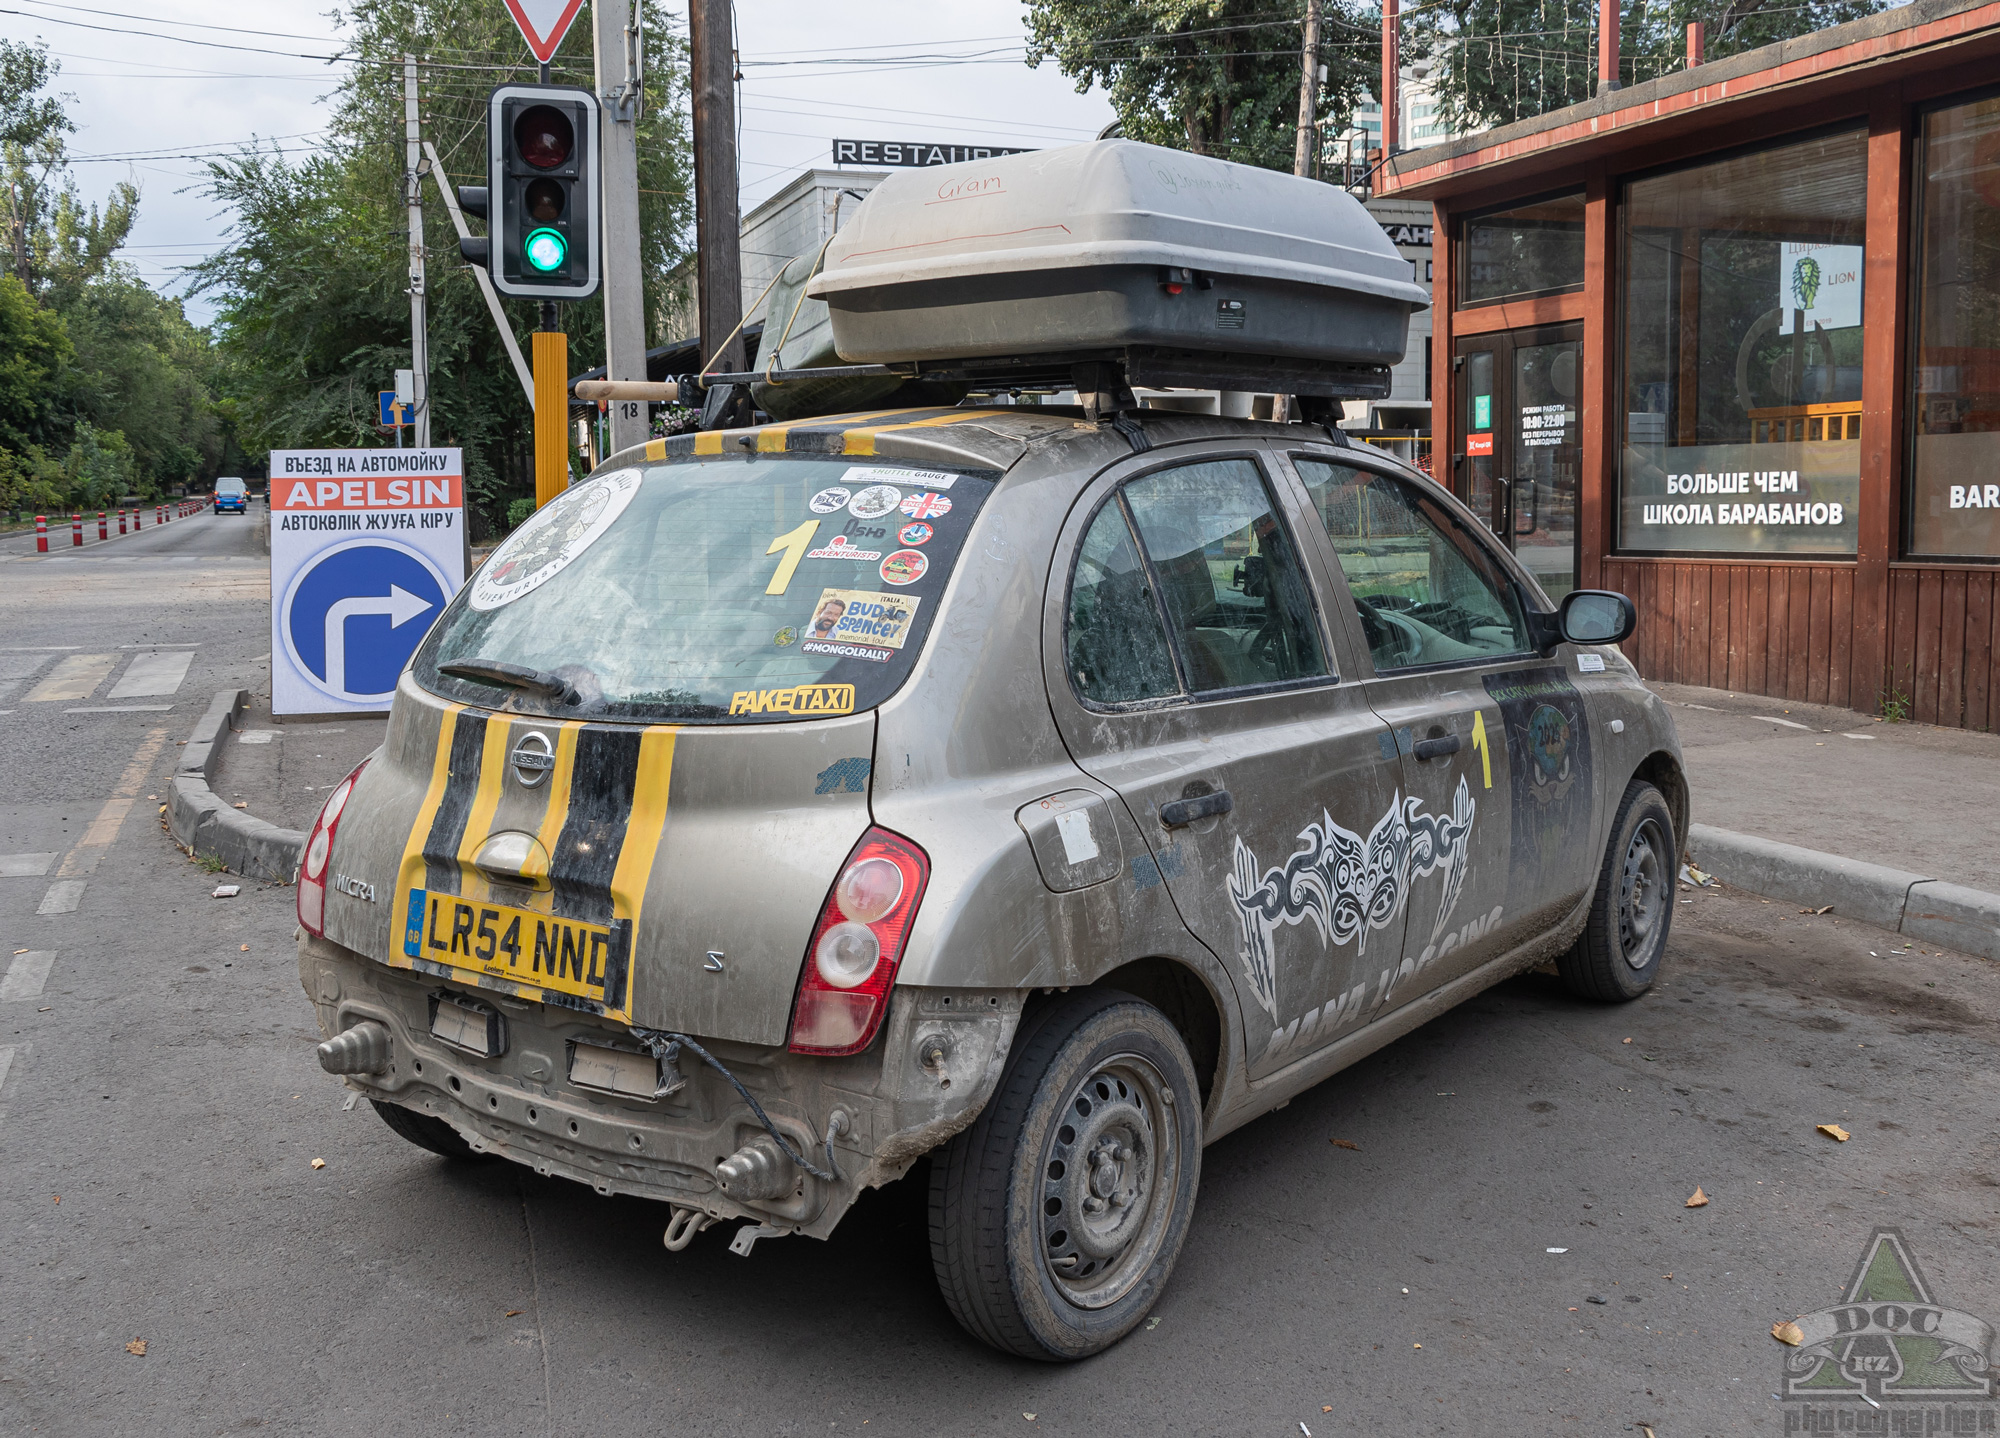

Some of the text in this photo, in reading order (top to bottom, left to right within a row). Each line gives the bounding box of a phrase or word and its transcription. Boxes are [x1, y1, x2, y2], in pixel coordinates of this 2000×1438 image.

[837, 141, 1025, 165] RESTAUR
[937, 176, 1001, 200] Gram
[1828, 271, 1856, 286] LION
[621, 402, 639, 420] 18
[1522, 404, 1565, 415] РЕЖИМ РАБОТЫ
[1522, 413, 1565, 430] 10:00-22:00
[1522, 429, 1565, 439] БЕЗ ПЕРЕРЫВОВ
[1530, 438, 1562, 446] ВЫХОДНЫХ
[285, 452, 447, 475] ВЪЕЗД НА АВТОМОЙКУ
[871, 468, 948, 480] SHUTTLE GAUGE
[1666, 470, 1799, 496] БОЛЬШЕ ЧЕМ
[285, 479, 450, 507] APELSIN
[901, 501, 952, 511] ENGLAND
[1643, 501, 1844, 525] ШКОЛА БАРАБАНОВ
[281, 512, 454, 531] АВТОКӨЛІК ЖУУҒА КІРУ
[765, 519, 820, 596] 1
[809, 550, 880, 561] ADVENTURISTS
[847, 601, 885, 618] BUD
[839, 634, 887, 645] memorial tour
[803, 642, 890, 661] #MONGOLRALLY
[1471, 711, 1493, 789] 1
[513, 754, 548, 768] NISSAN
[1041, 796, 1066, 812] 95
[335, 873, 376, 903] MICRA
[407, 929, 419, 944] GB
[428, 899, 610, 988] LR54 NND
[704, 950, 725, 972] S
